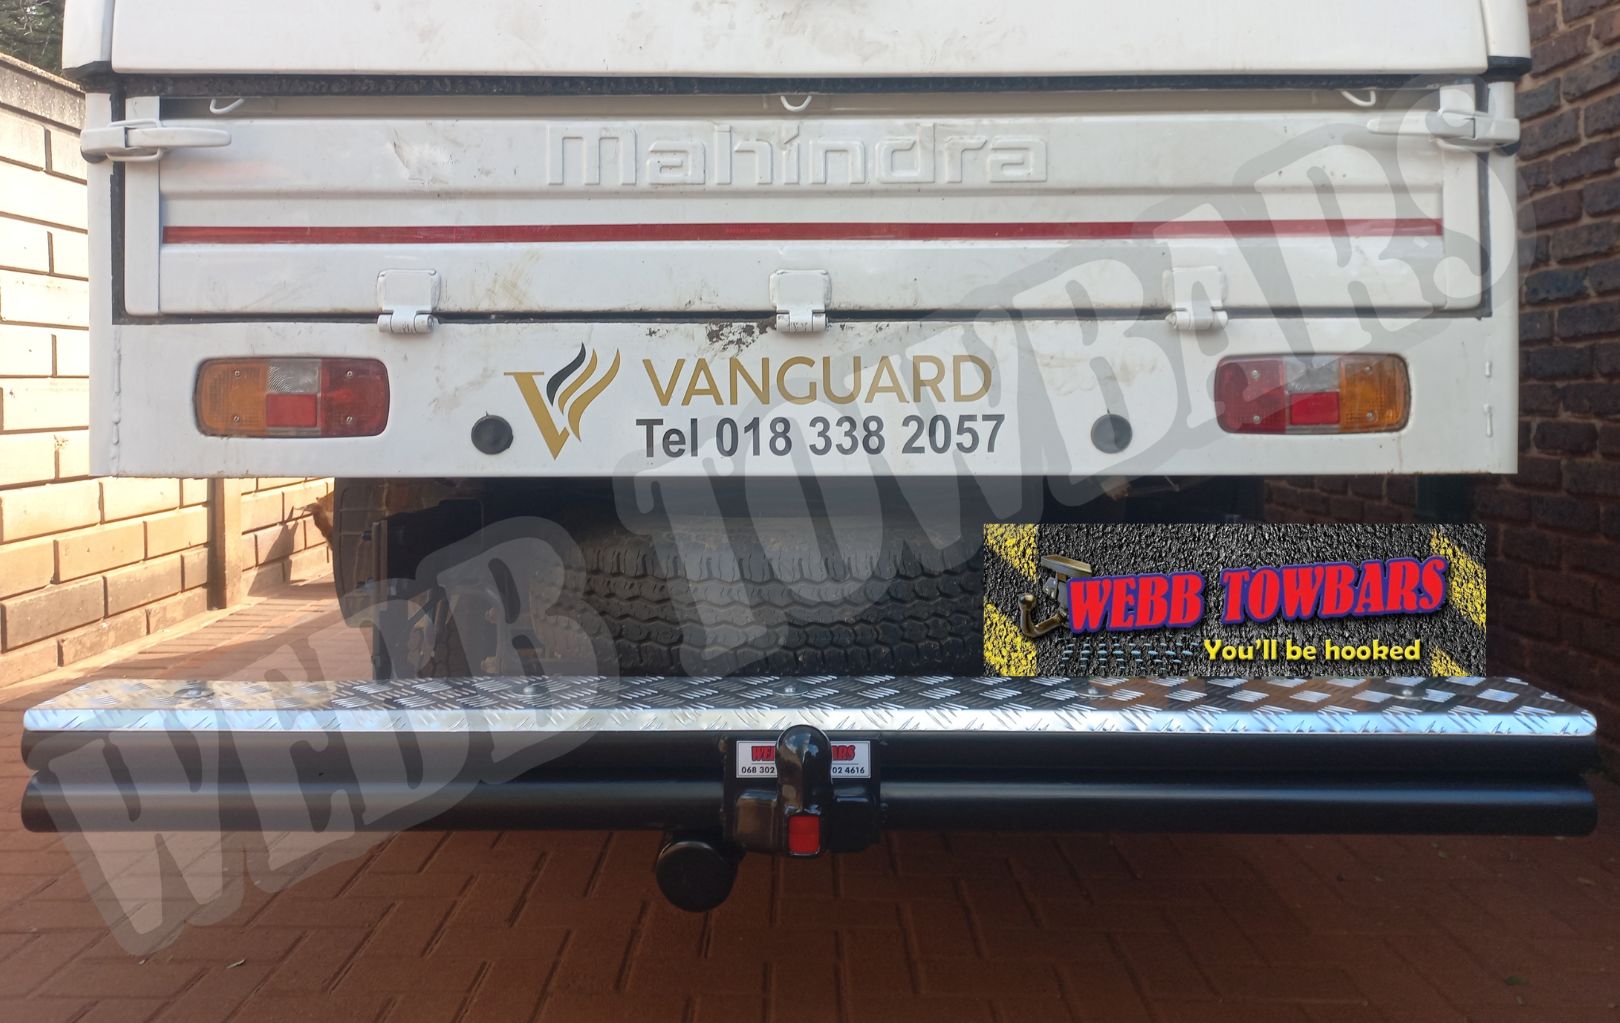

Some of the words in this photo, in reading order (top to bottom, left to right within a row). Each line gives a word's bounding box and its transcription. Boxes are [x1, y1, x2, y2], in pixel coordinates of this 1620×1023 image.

[641, 354, 993, 406] VANGUARD
[636, 417, 699, 458] Tel
[715, 416, 793, 456] 018
[808, 415, 886, 456] 338
[901, 414, 1006, 454] 2057
[741, 766, 757, 774] 068
[759, 766, 776, 774] 302
[832, 766, 843, 774] 02
[844, 766, 865, 774] 4616
